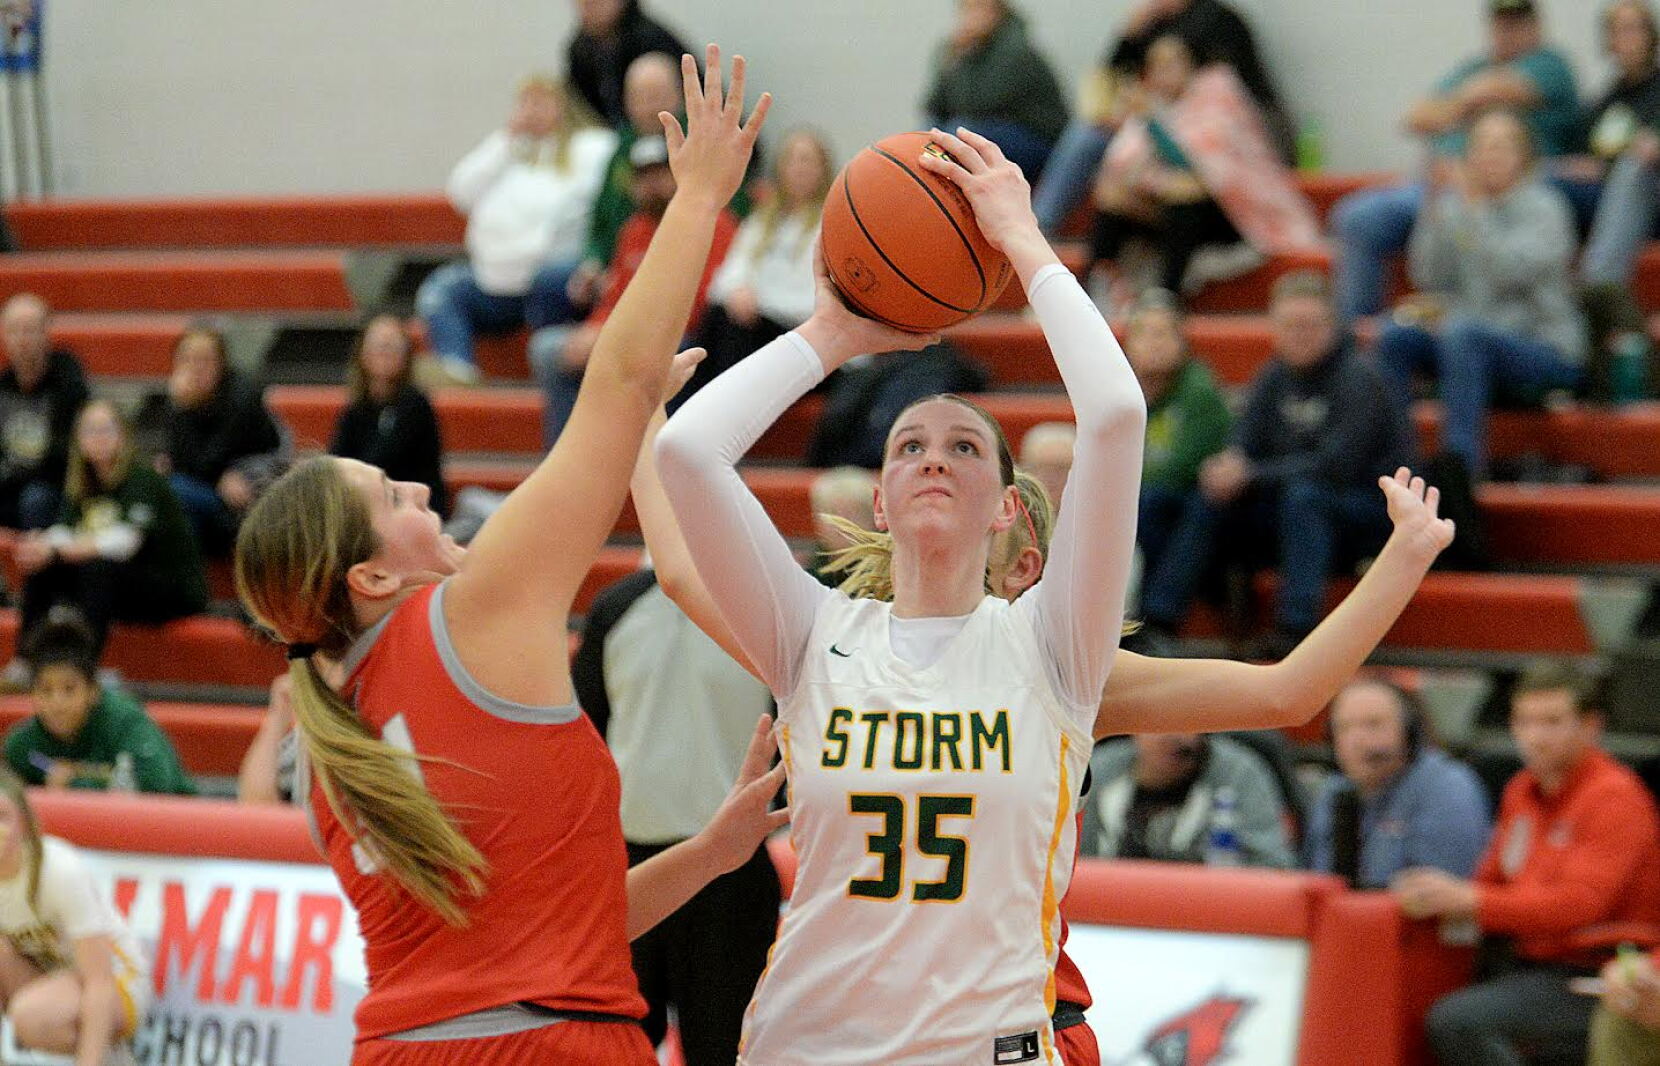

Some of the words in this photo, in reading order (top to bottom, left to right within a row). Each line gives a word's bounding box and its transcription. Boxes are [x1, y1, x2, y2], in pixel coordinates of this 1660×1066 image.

[820, 707, 1013, 773] STORM
[846, 791, 977, 904] 35
[113, 876, 344, 1015] MAR
[1026, 1042, 1035, 1053] L
